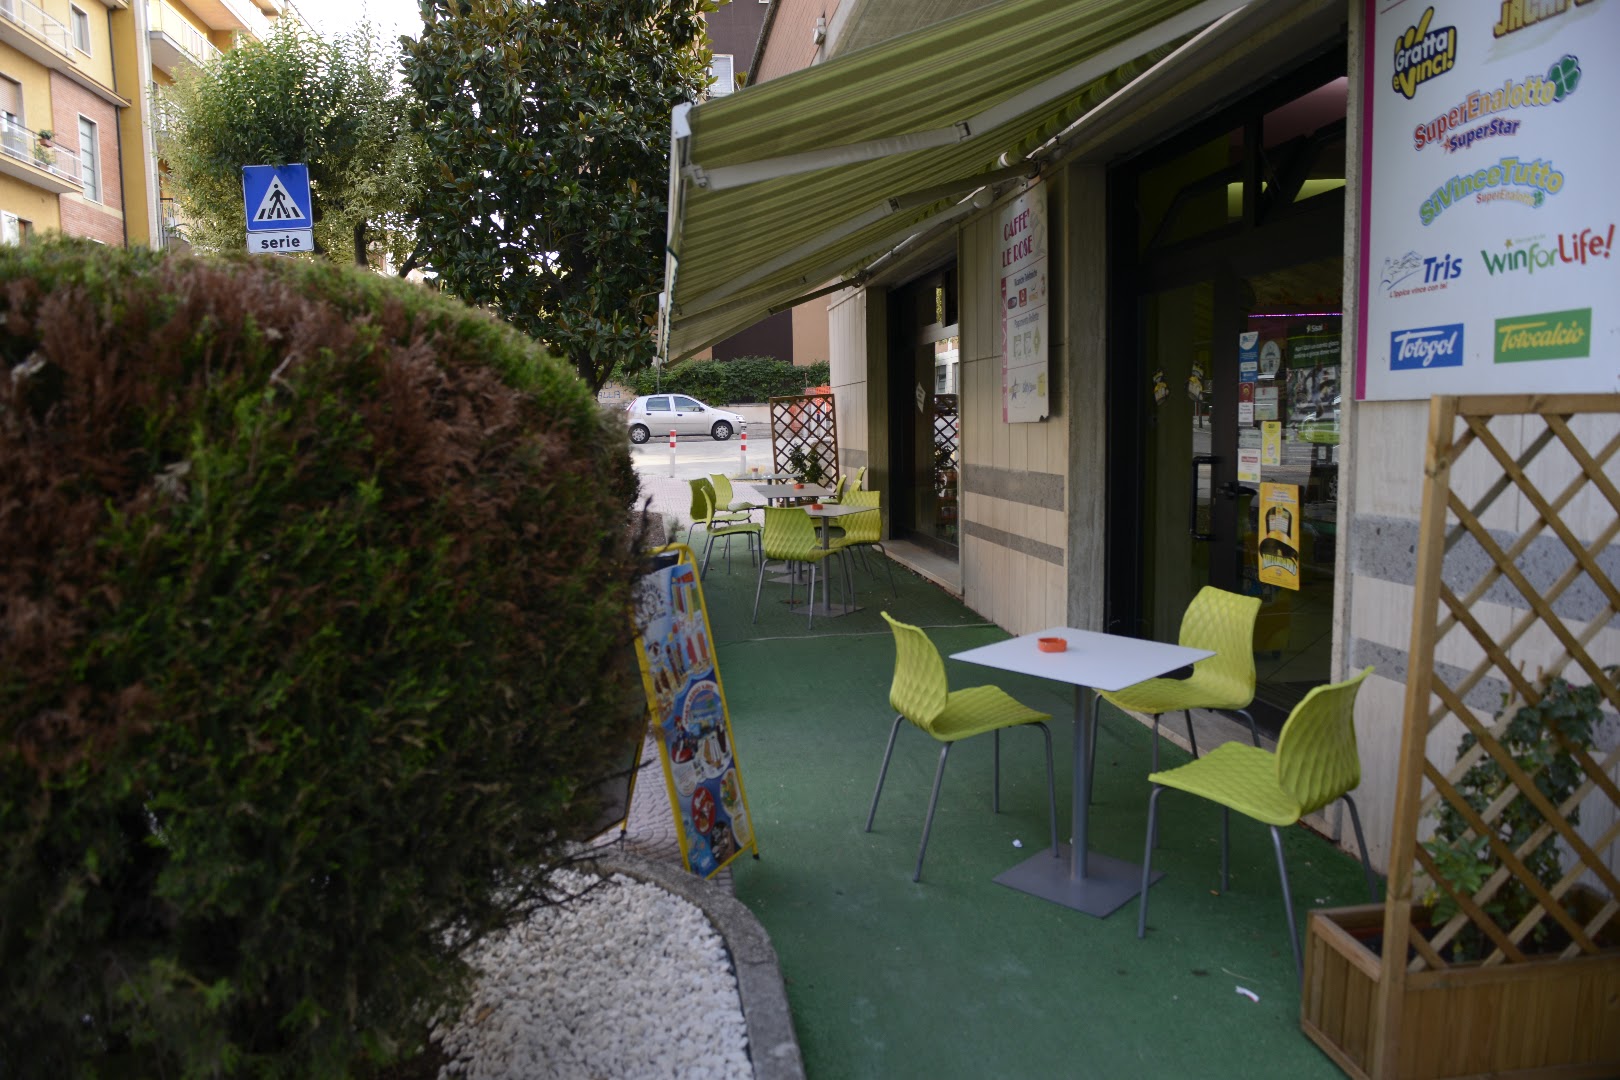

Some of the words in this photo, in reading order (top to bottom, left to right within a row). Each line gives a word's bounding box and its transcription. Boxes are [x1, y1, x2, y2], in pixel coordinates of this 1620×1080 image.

[1395, 32, 1449, 71] Gratta
[1414, 75, 1557, 151] SuperEnalotto
[1449, 118, 1521, 152] SuperStar
[261, 235, 301, 249] serie
[1002, 248, 1012, 267] LE
[1013, 235, 1033, 262] ROSE
[1423, 254, 1463, 283] Tris
[1394, 330, 1459, 367] Totogol
[1498, 321, 1585, 352] Totocalcio
